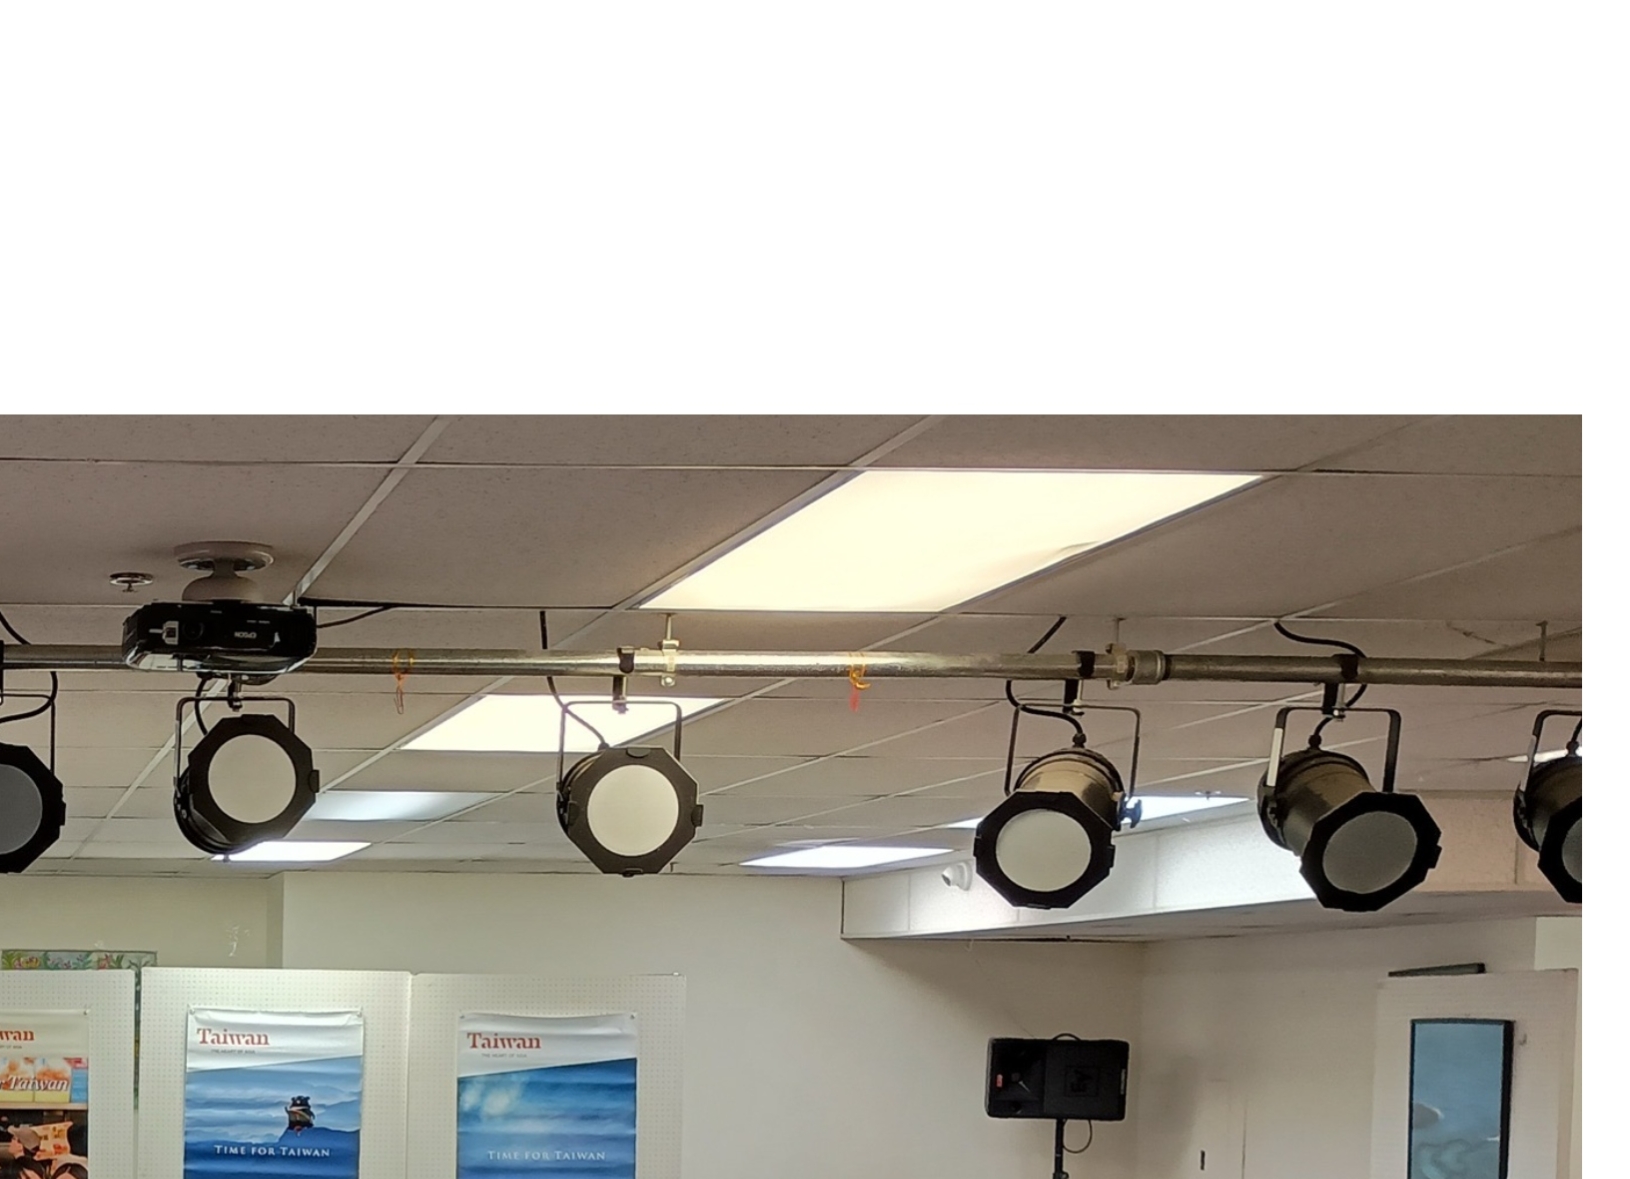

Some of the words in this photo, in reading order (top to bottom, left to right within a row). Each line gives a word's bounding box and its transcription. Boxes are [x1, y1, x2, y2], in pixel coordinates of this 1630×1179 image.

[197, 1028, 270, 1046] Taiwan
[467, 1032, 541, 1049] Taiwan
[7, 1075, 70, 1091] Taiwan
[214, 1145, 246, 1155] TIME
[251, 1146, 275, 1156] FOR
[279, 1146, 330, 1157] TAIWAN
[487, 1150, 519, 1160] TIME
[524, 1151, 550, 1160] FOR
[554, 1151, 606, 1161] TAIWAN
